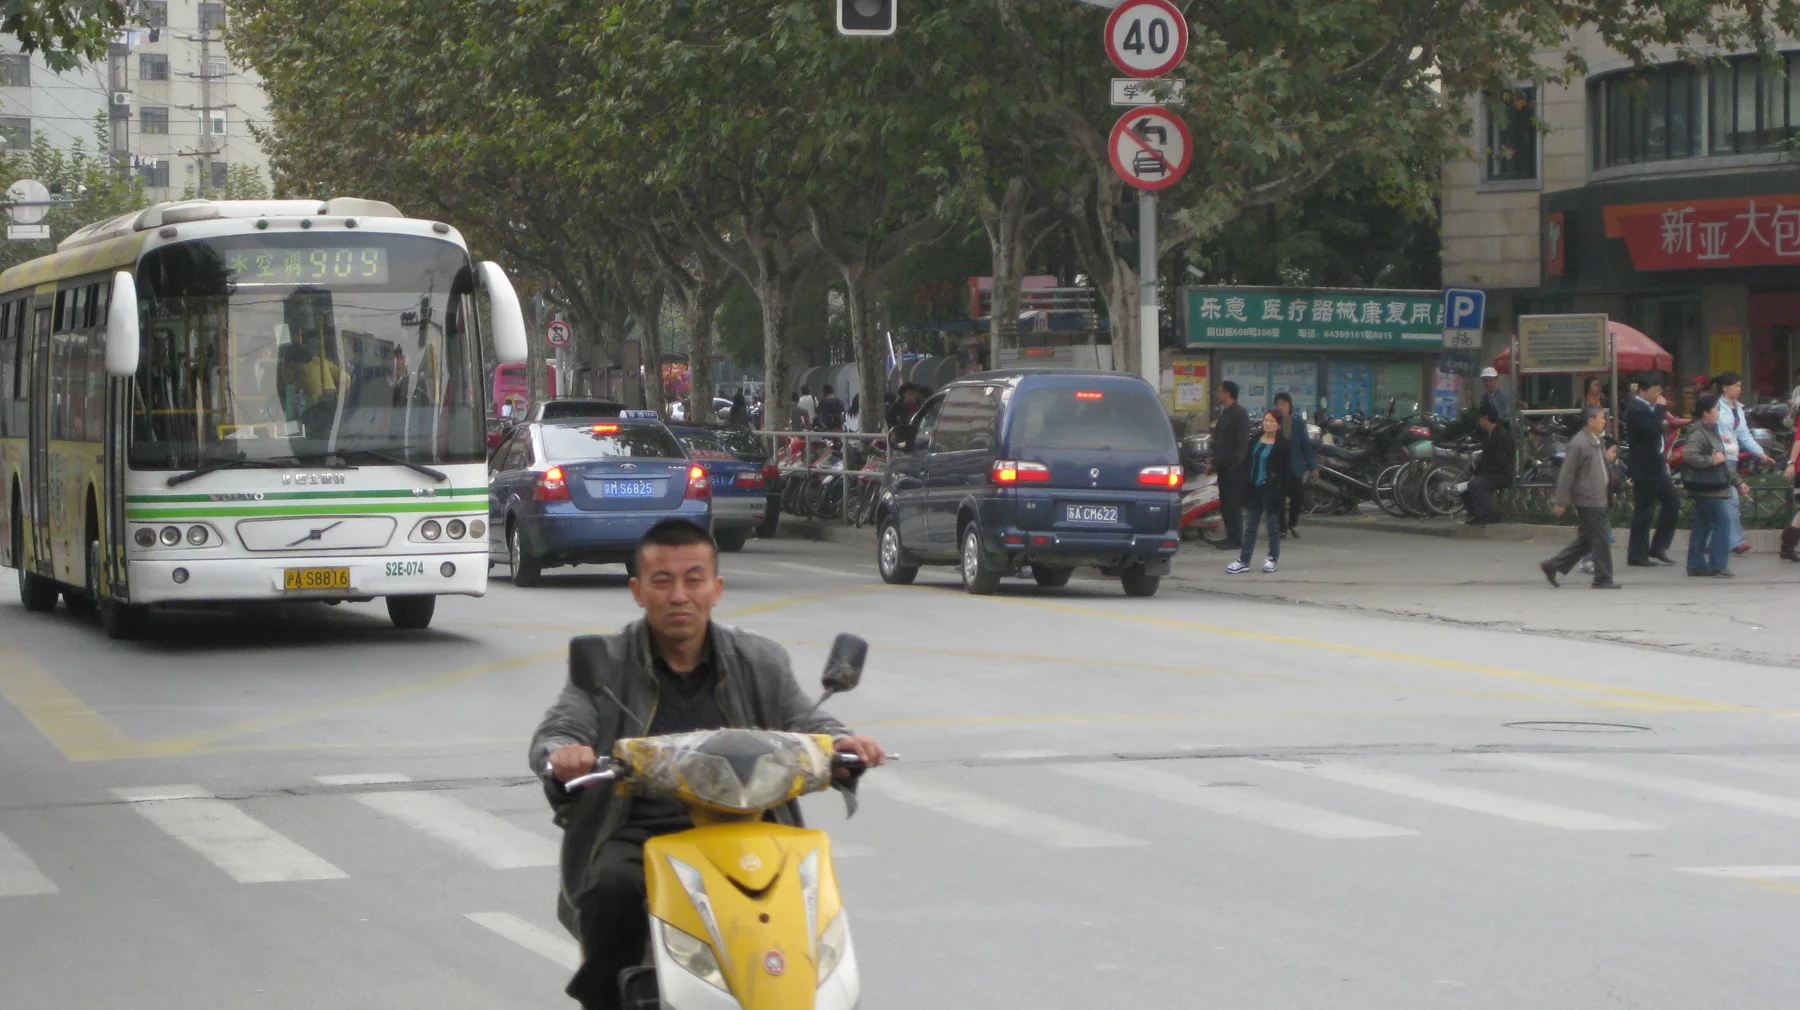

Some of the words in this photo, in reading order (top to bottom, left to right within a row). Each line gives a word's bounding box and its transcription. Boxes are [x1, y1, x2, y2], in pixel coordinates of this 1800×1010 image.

[1123, 18, 1170, 55] 40
[1661, 200, 1800, 259] 新亚大包
[310, 249, 378, 278] 909
[1200, 297, 1248, 322] 乐意
[1453, 295, 1475, 327] P
[385, 561, 424, 577] S2E-074
